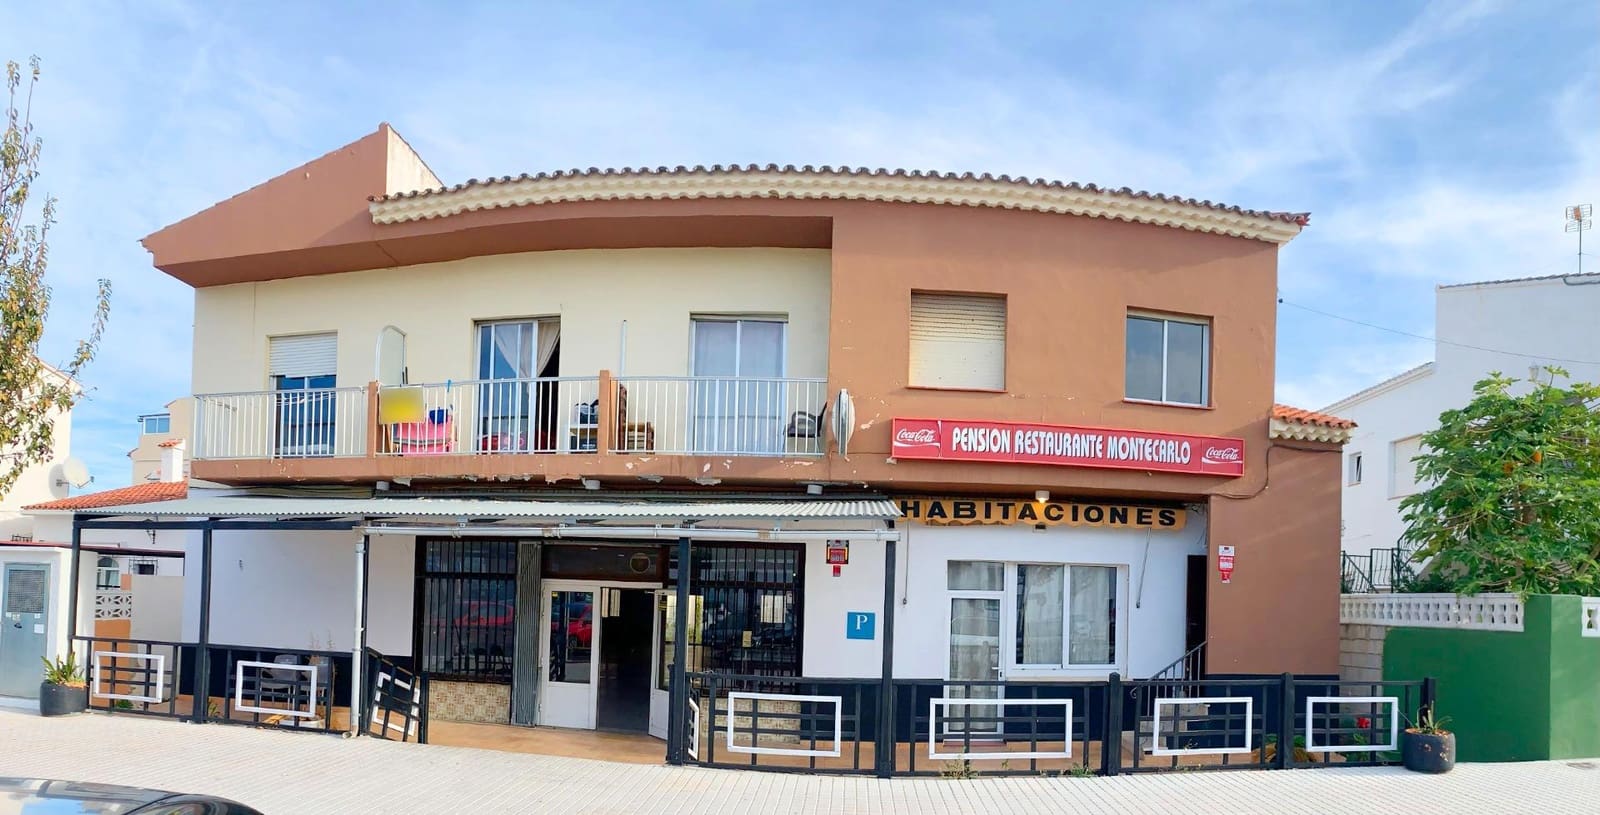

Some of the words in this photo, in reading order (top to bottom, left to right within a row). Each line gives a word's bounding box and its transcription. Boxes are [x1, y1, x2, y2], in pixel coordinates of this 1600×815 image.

[952, 427, 1010, 453] PENSION
[1014, 430, 1103, 458] RESTAURANTE
[1107, 436, 1191, 464] MONTECARLO
[900, 500, 1176, 526] HABITACIONES
[855, 614, 868, 630] P
